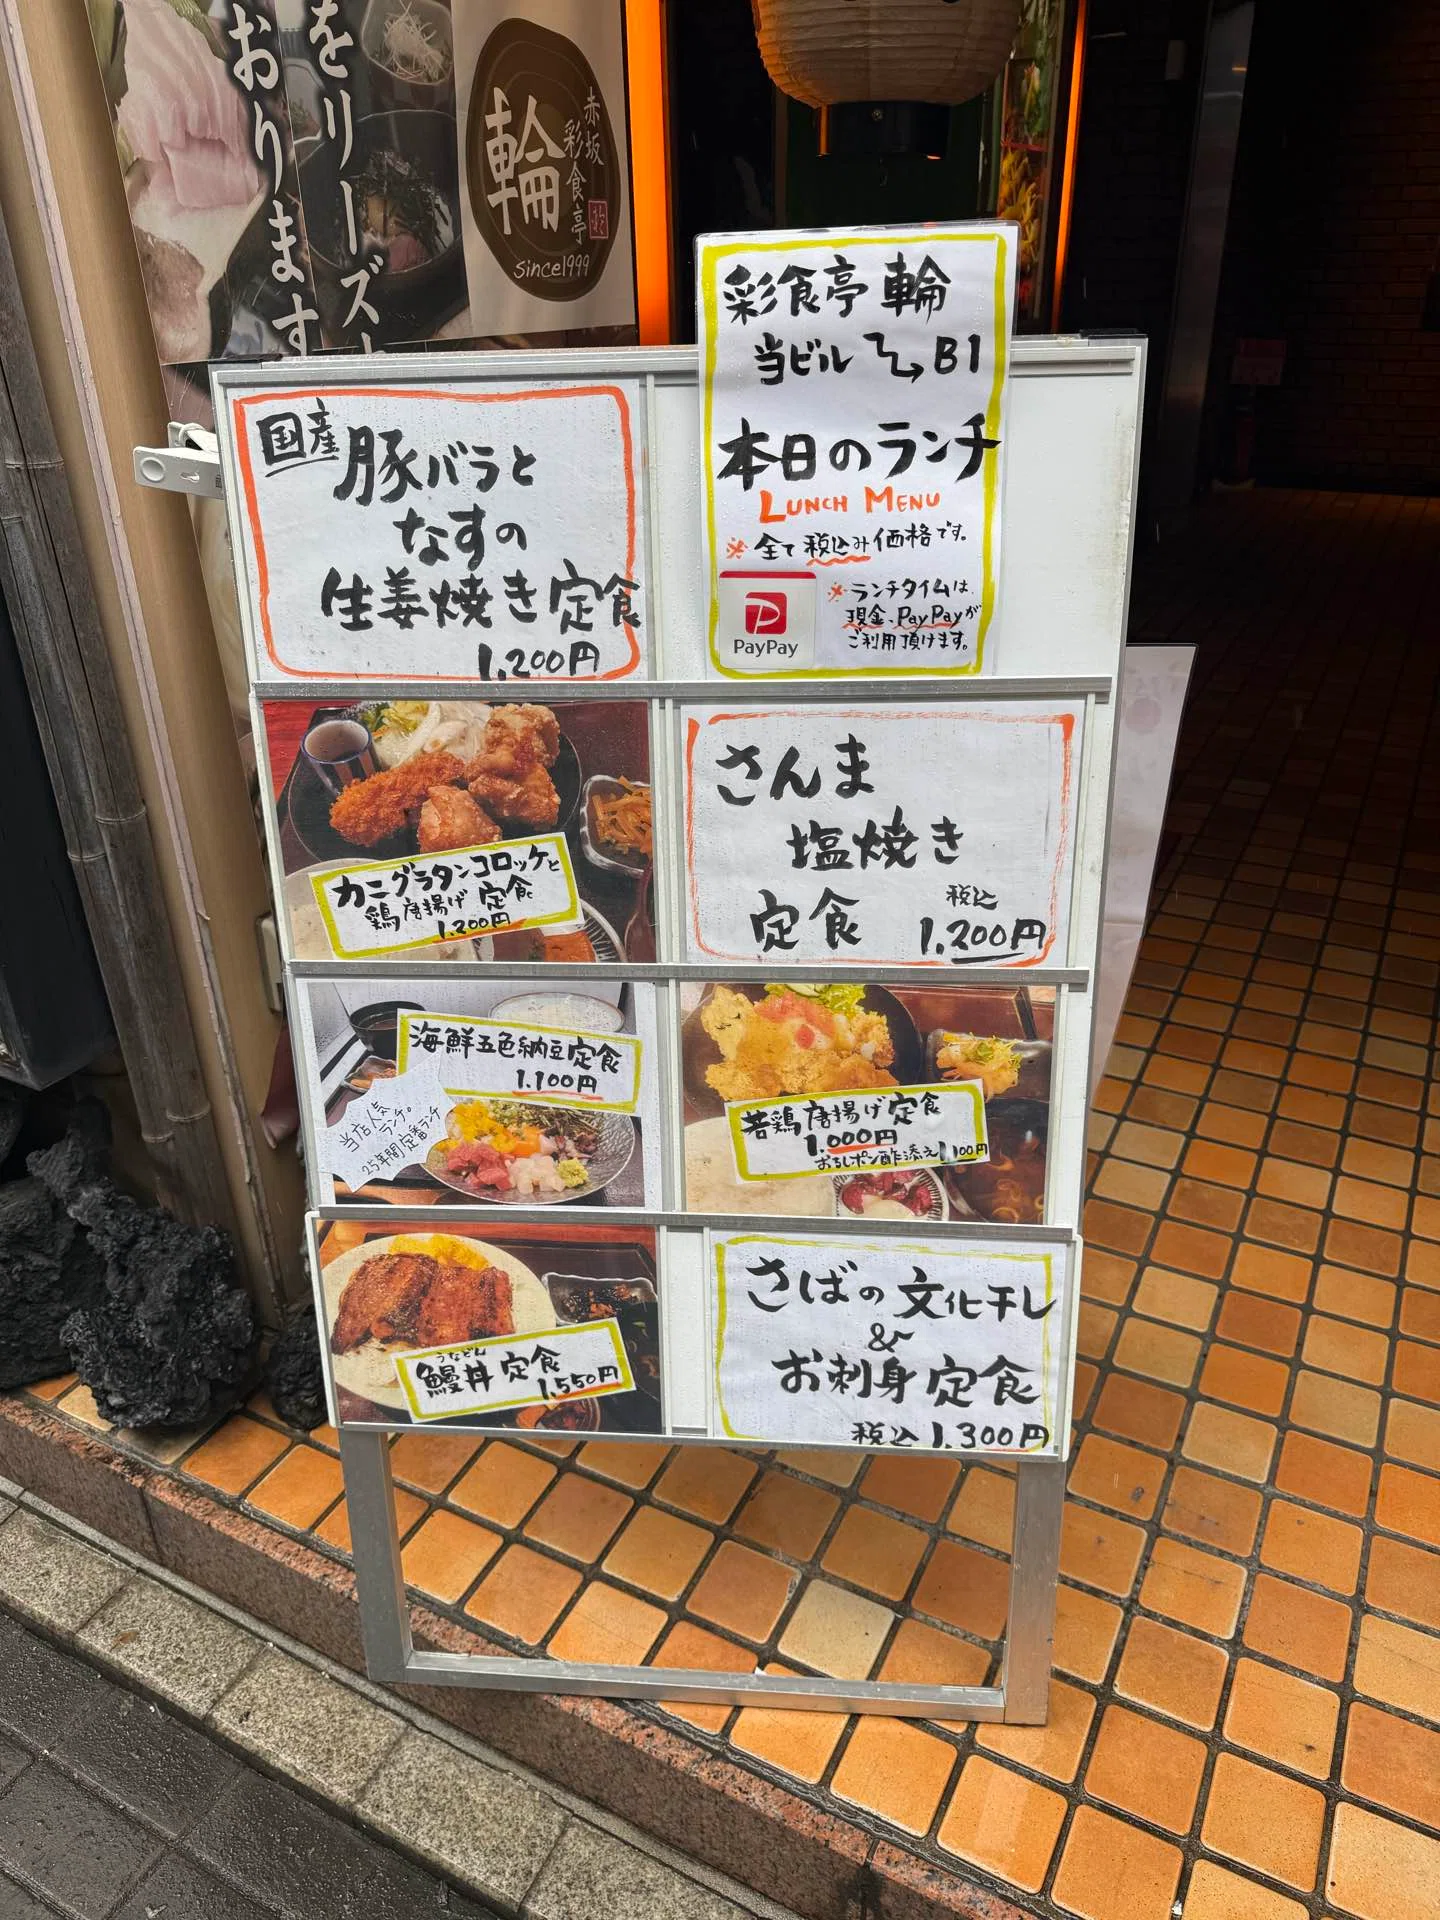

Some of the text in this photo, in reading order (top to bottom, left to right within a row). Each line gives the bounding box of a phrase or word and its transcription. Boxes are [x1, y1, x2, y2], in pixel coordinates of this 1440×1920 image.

[583, 86, 605, 166] 赤坂
[228, 3, 320, 356] おります
[484, 86, 567, 236] 輪
[562, 118, 590, 246] 彩食亭
[753, 332, 982, 387] 当ビル B1
[256, 397, 537, 507] 国産 豚バラと
[716, 412, 1003, 492] 本日のランチ
[393, 503, 527, 571] なすの
[759, 485, 941, 524] LUNCH MENU
[320, 558, 642, 635] 生姜焼き定食
[733, 639, 800, 658] PayPay
[715, 733, 875, 807] さんま
[786, 805, 964, 871] 塩焼き
[332, 844, 560, 908] カニグラタンコロッケと
[364, 874, 534, 932] 鶏唐揚げ定食
[946, 884, 998, 910] 税込
[749, 886, 862, 952] 定食
[409, 1021, 623, 1074] 海鮮五色納豆定食
[339, 1101, 391, 1153] 当店人気
[361, 1105, 442, 1176] 25年間定番ランチ
[741, 1091, 941, 1140] 若鶏唐揚げ定食
[745, 1256, 1057, 1322] さばの文化干し
[436, 1346, 487, 1363] うなどん
[867, 1322, 916, 1353] &
[771, 1348, 1041, 1408] お刺身定食
[850, 1420, 919, 1446] 税込
